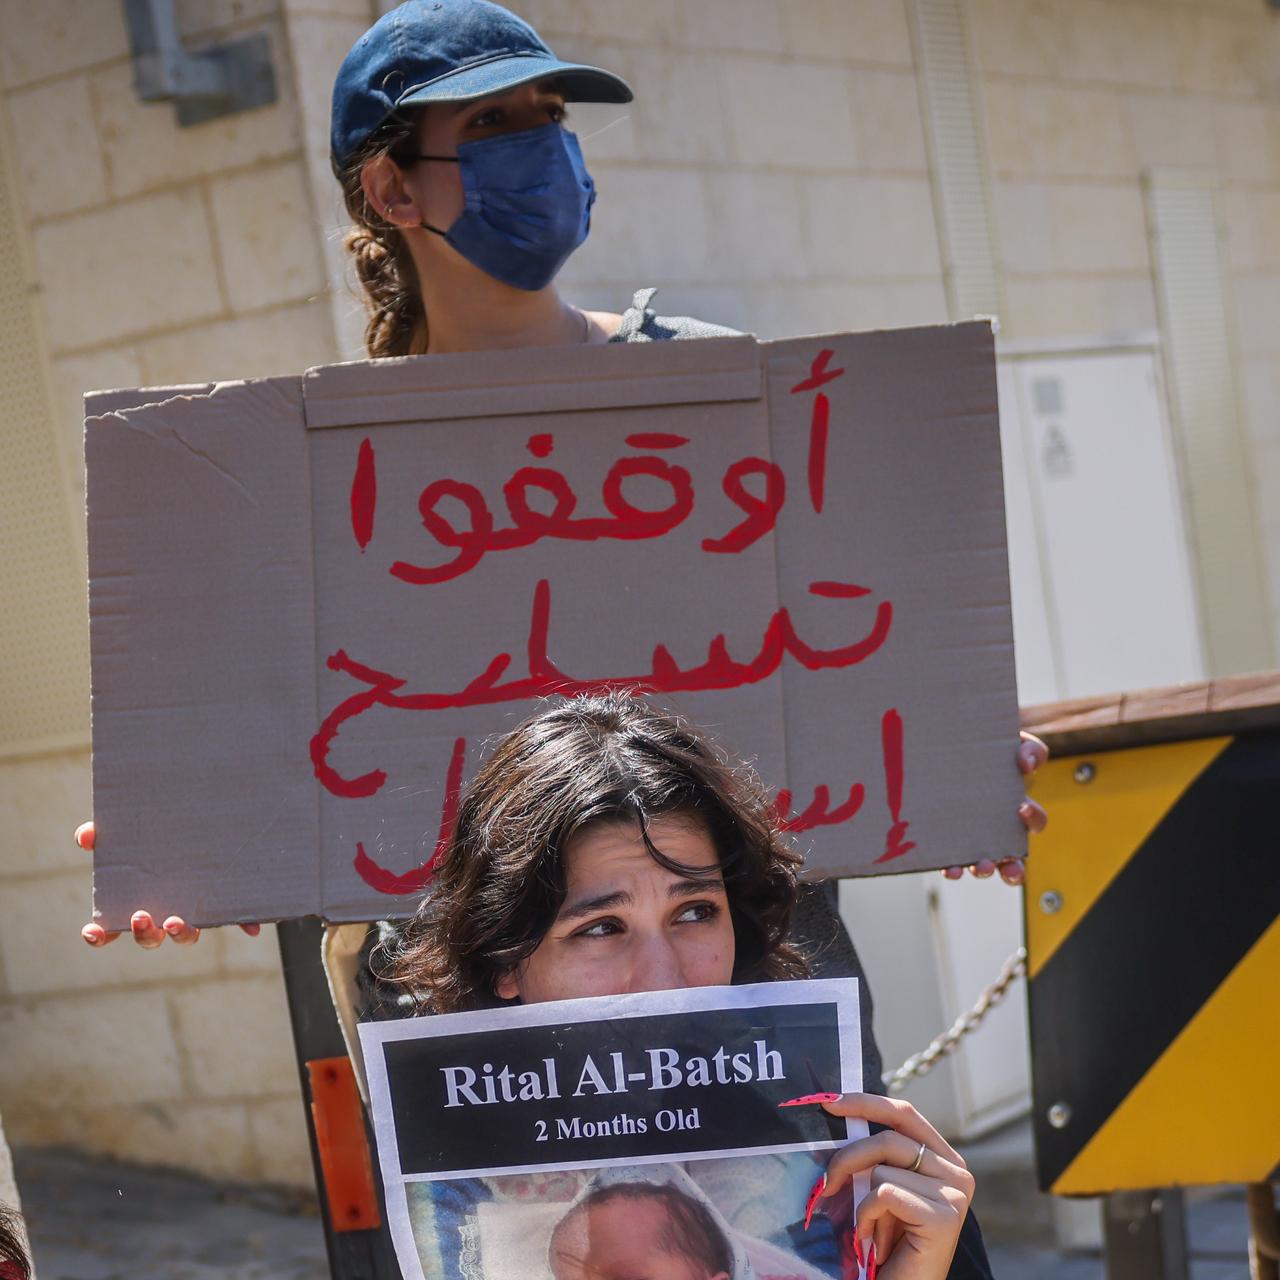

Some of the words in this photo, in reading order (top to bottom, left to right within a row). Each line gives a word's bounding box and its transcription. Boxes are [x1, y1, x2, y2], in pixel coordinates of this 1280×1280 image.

[349, 349, 846, 585] أوقفوا
[439, 1058, 560, 1109] Rital
[572, 1039, 787, 1098] Al-Batsh
[534, 1119, 549, 1142] 2
[556, 1112, 648, 1141] Months
[654, 1107, 701, 1132] Old
